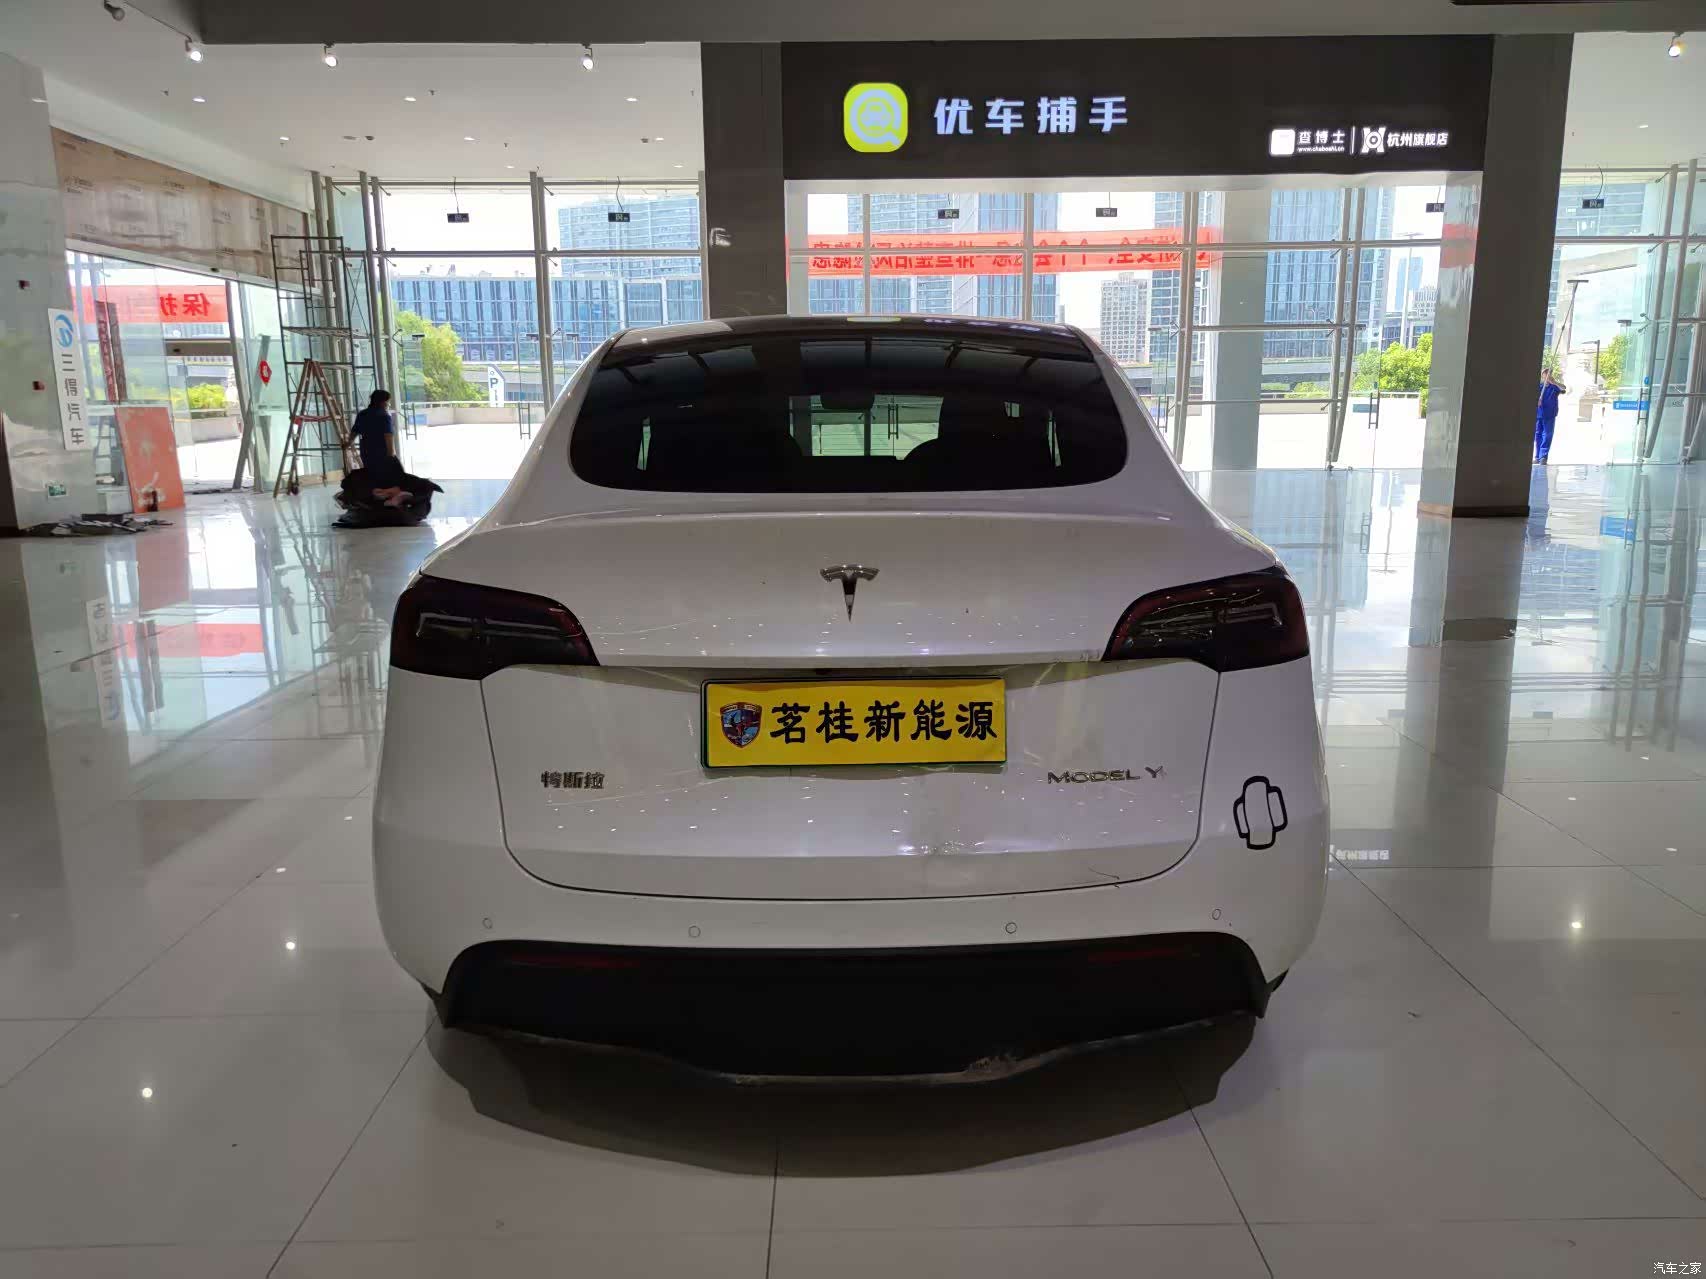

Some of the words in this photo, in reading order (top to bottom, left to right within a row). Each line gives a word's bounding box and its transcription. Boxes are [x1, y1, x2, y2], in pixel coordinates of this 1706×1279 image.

[934, 97, 1128, 134] 优车捕手
[1299, 130, 1345, 144] 查博士
[1387, 132, 1448, 147] 杭州旗舰店
[770, 699, 997, 743] 茗桂新能源
[1047, 769, 1141, 784] MODEL
[1145, 765, 1163, 778] Y
